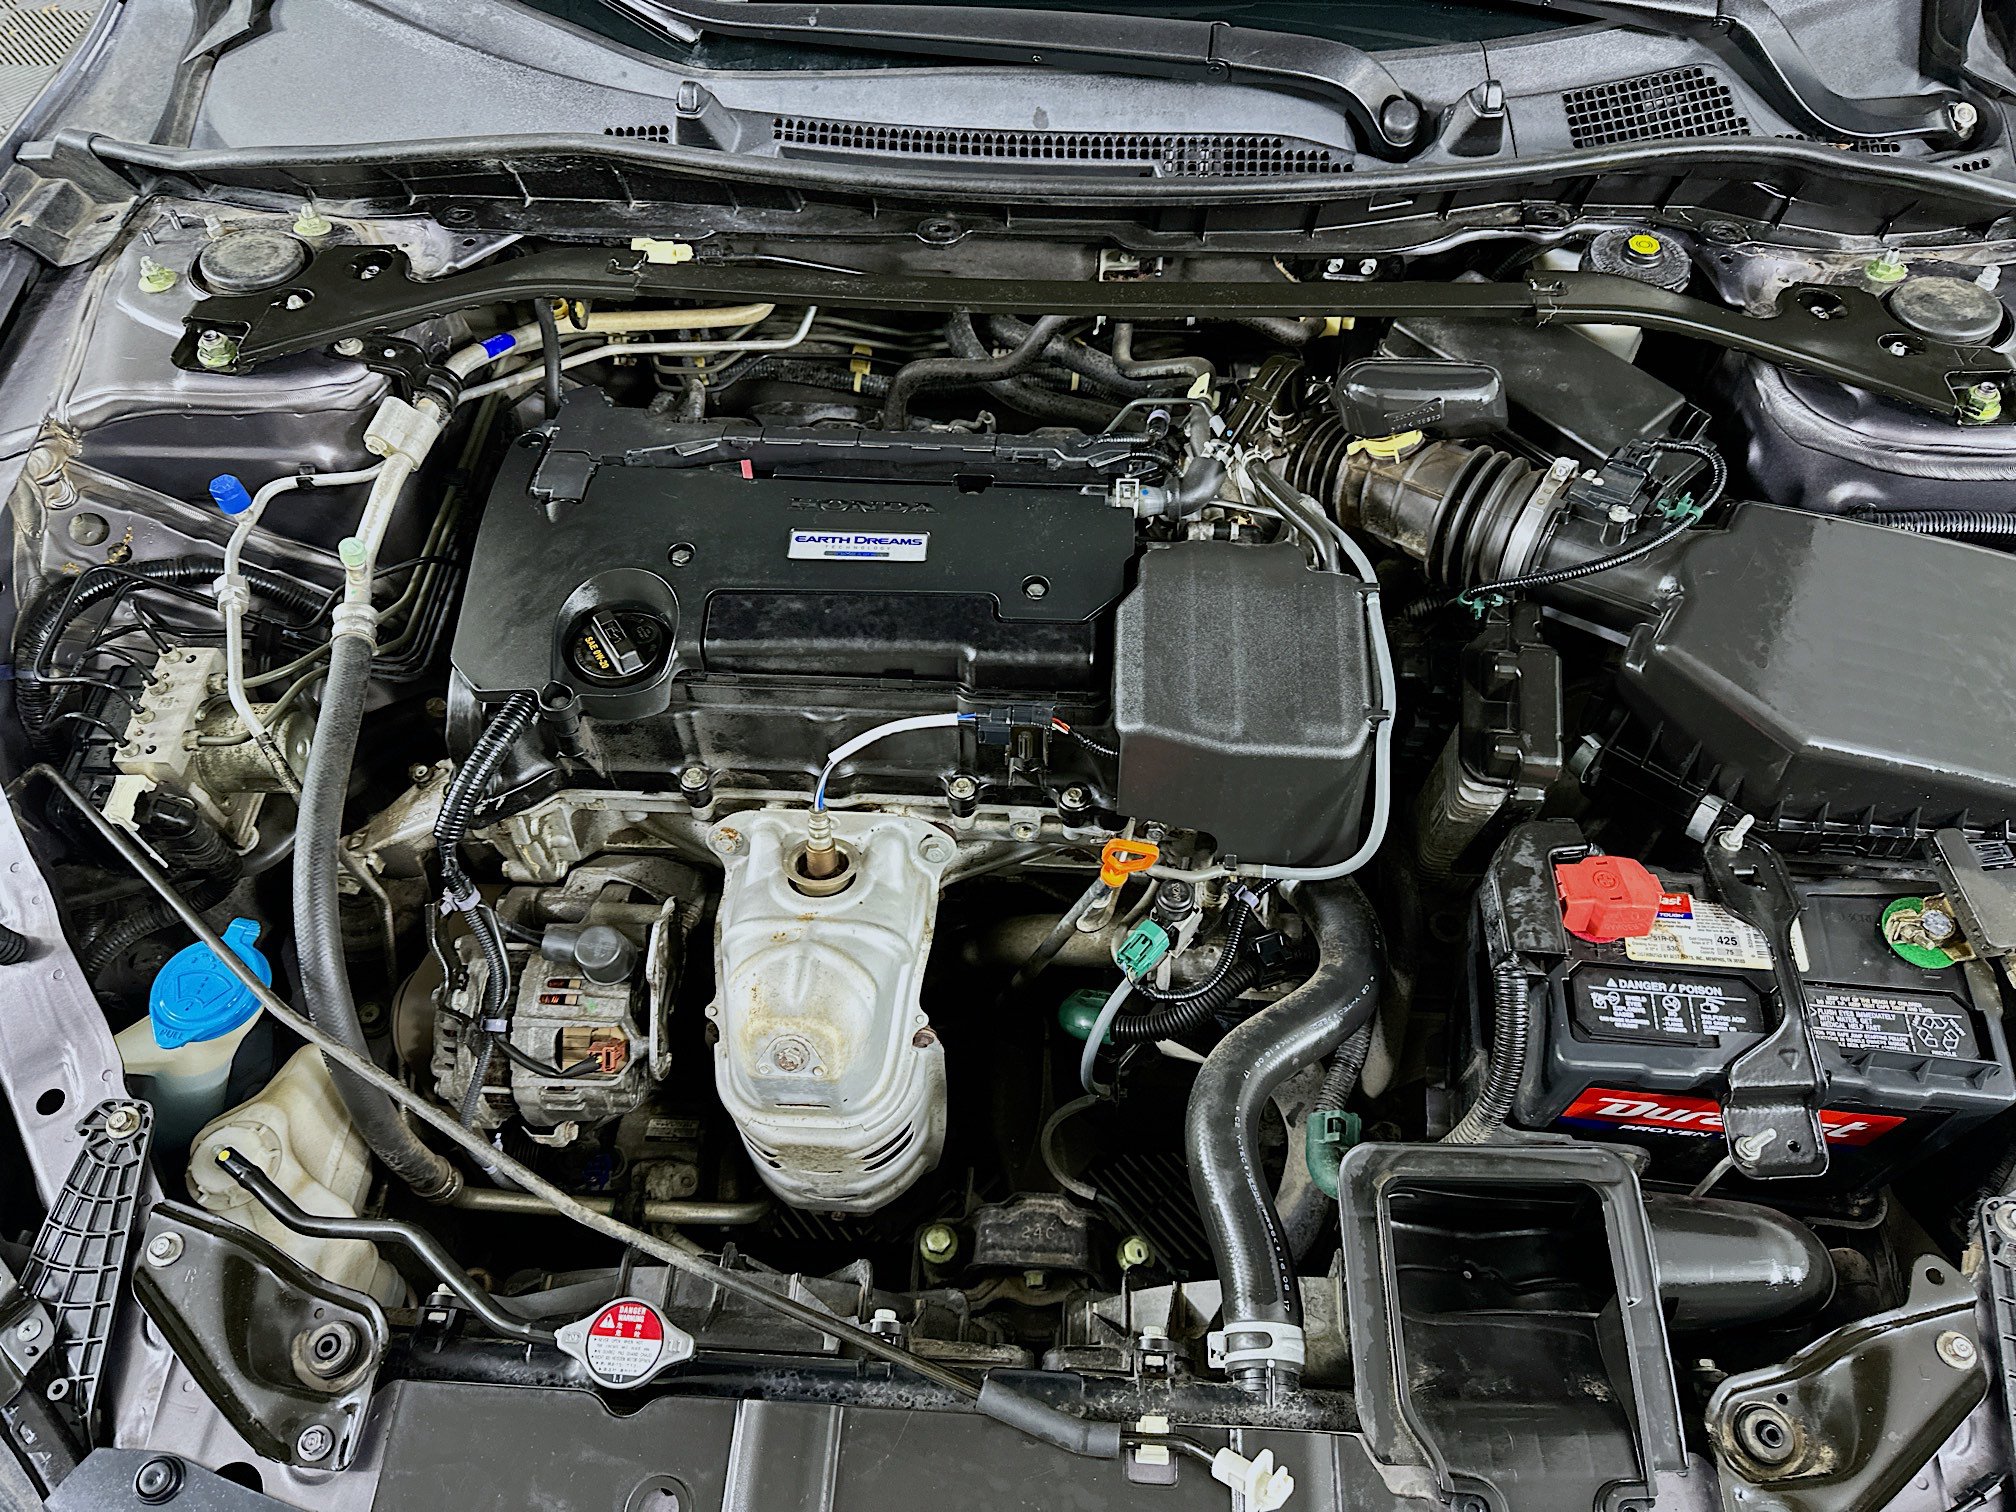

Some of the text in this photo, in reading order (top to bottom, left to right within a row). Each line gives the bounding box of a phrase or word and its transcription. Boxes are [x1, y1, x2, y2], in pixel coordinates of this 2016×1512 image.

[786, 497, 940, 514] HONDA
[794, 535, 923, 546] EARTH DREAMS
[584, 636, 610, 669] SAE 0W-20
[1716, 936, 1738, 946] 425
[1618, 979, 1667, 993] DANGER
[1678, 984, 1723, 996] POISON
[1817, 1008, 1896, 1020] FLUSH EYES IMMEDIATELY
[1820, 1021, 1881, 1032] MEDICAL HELP FAST
[160, 1028, 184, 1041] PULL
[1618, 1125, 1713, 1137] PROVEN
[619, 1306, 647, 1315] DANGER
[612, 1374, 623, 1383] 1.1
